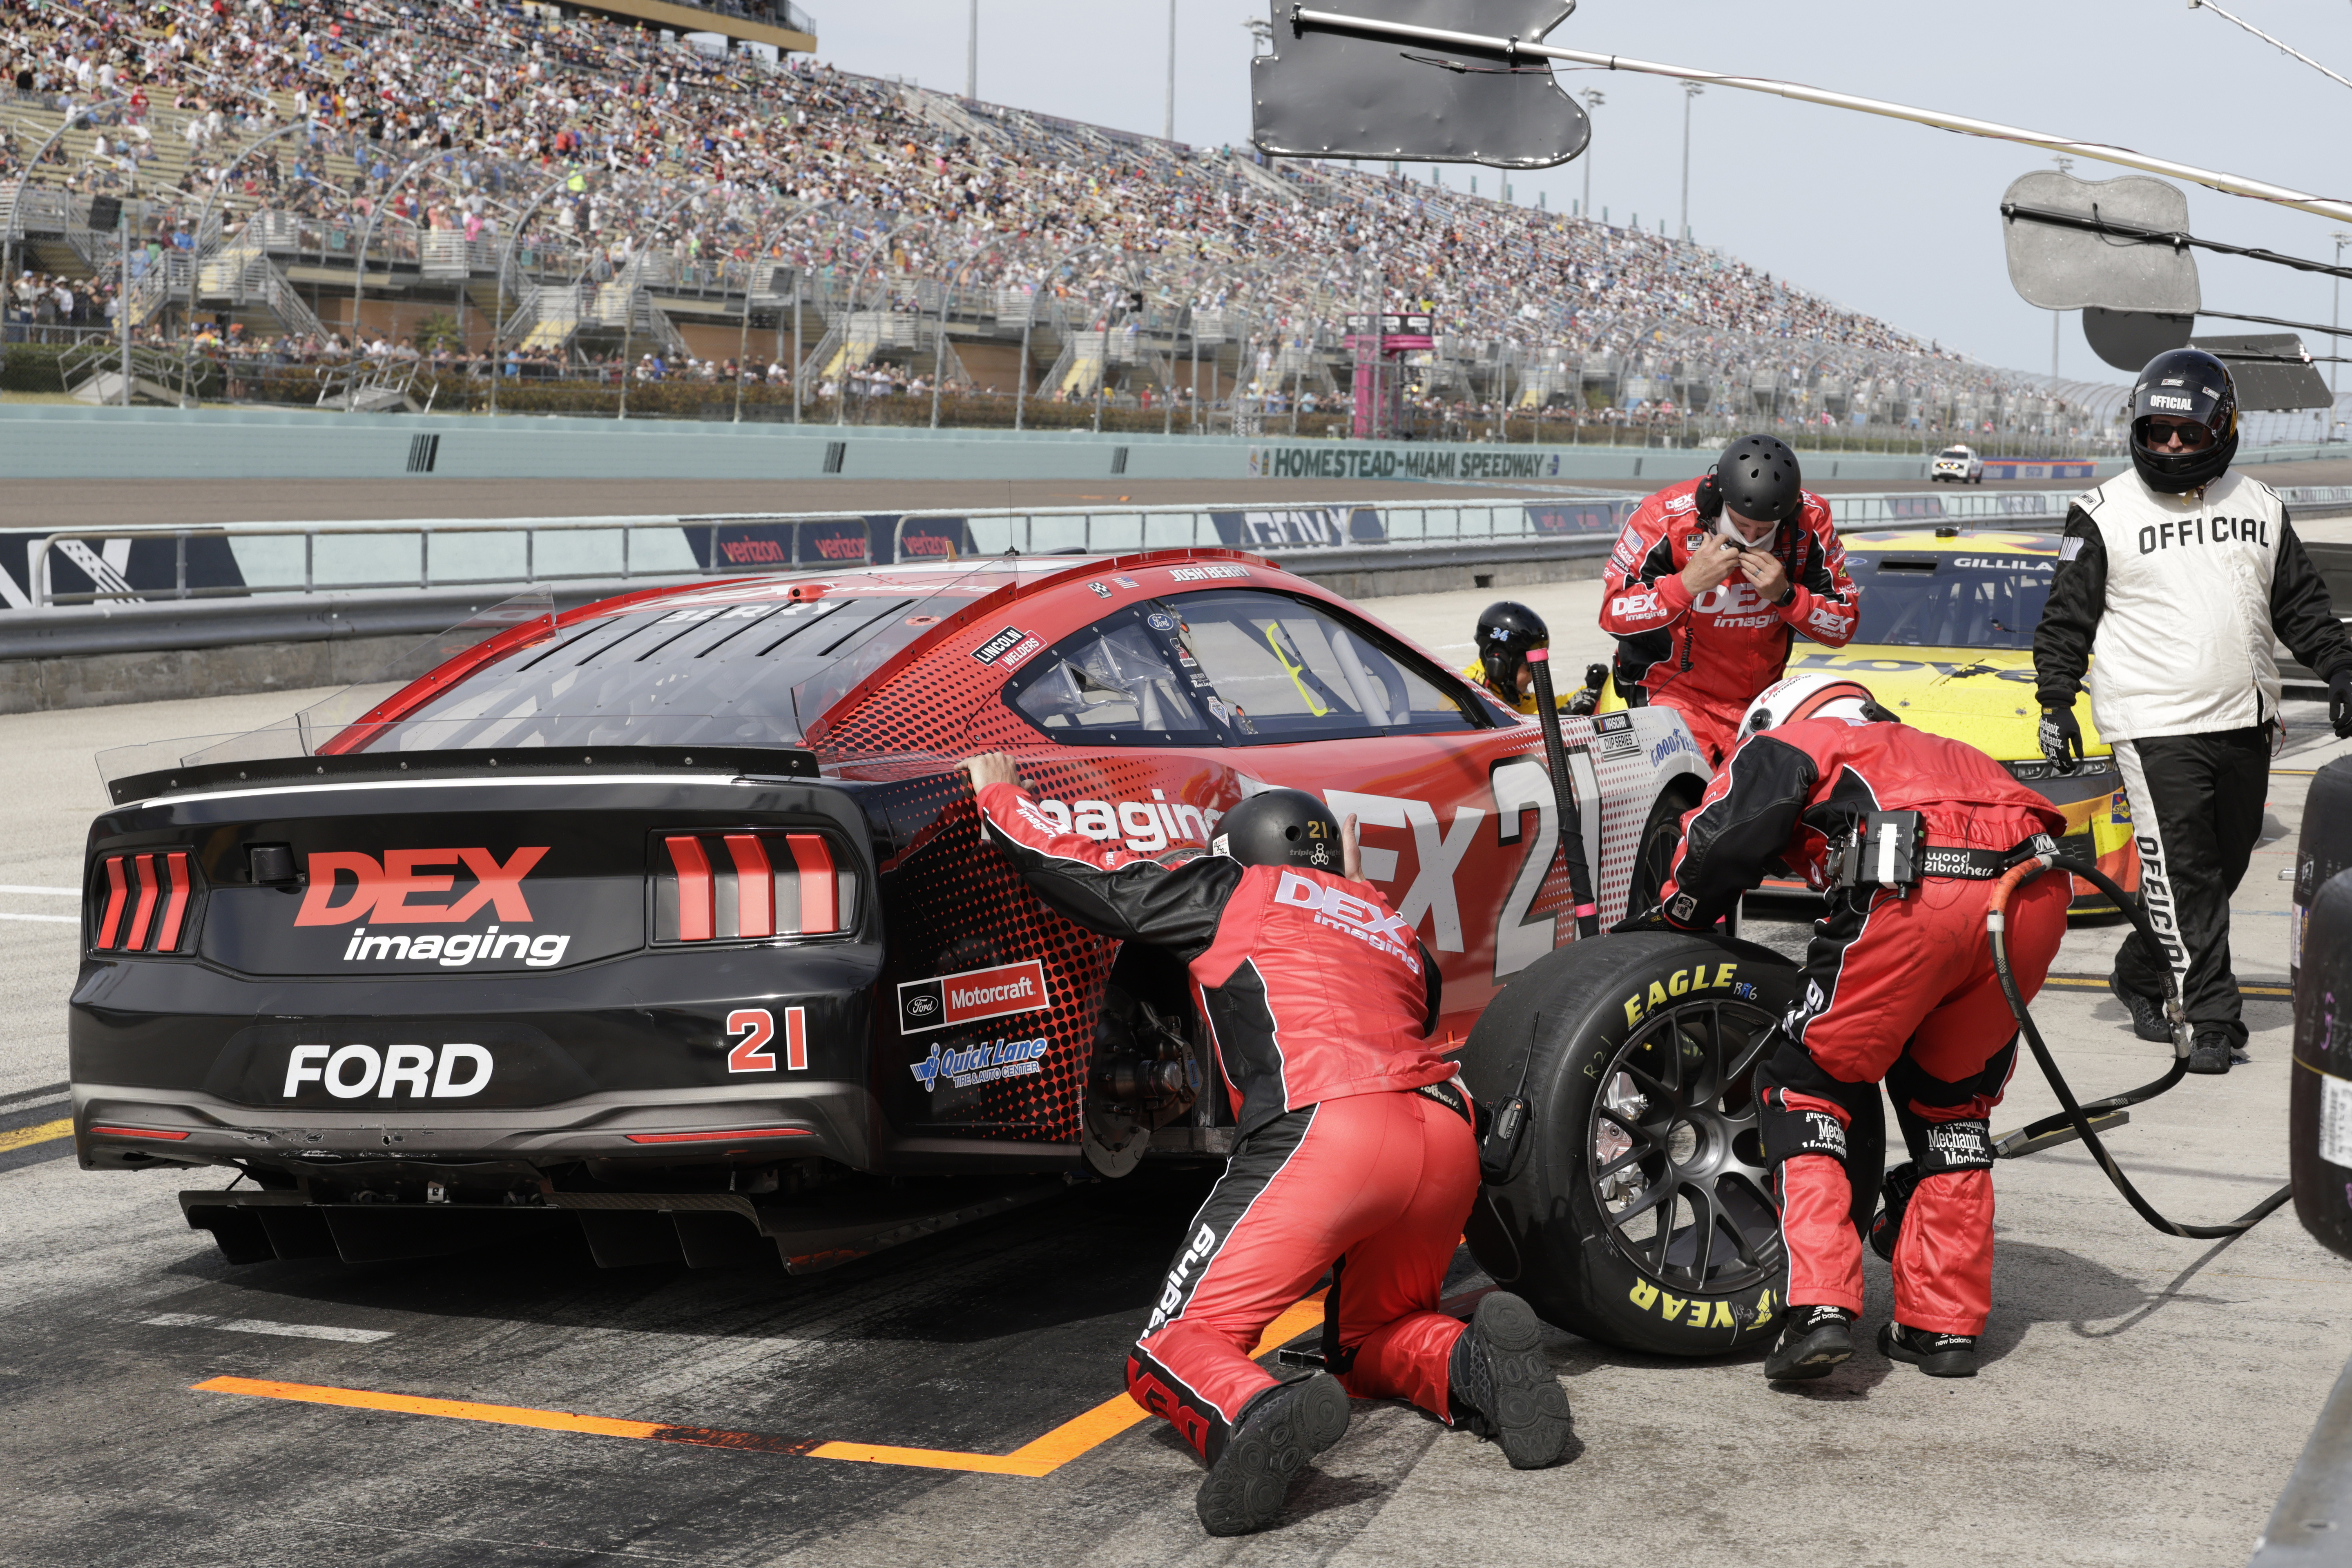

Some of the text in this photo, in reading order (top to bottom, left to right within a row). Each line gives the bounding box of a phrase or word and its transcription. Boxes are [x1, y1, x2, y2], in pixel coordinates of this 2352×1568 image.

[2150, 395, 2192, 410] OFFICIAL
[1274, 448, 1545, 477] HOMESTEAD-MIAMI SPEEDWAY
[1665, 493, 1694, 509] DEX
[2139, 517, 2269, 555] OFFICIAL
[720, 535, 785, 562] verizon
[1617, 543, 1636, 562] FORD
[1168, 565, 1251, 582] JOSH BERRY
[1611, 554, 1629, 571] LINCOLN
[1954, 558, 2055, 571] GILLILA
[655, 600, 858, 623] BERRY
[1612, 592, 1658, 616] DEX
[1626, 608, 1667, 621] imaging
[1151, 615, 1170, 628] Ford
[1809, 608, 1854, 633] DEX
[1490, 627, 1510, 641] 34
[1812, 626, 1848, 640] imaging
[976, 629, 1023, 662] LINCOLN
[1002, 637, 1040, 667] WELDERS
[1191, 680, 1213, 688] Racing
[1760, 674, 1802, 705] DEX
[1773, 674, 1811, 698] imaging
[1605, 715, 1627, 731] NASCAR
[1604, 734, 1633, 750] CUP SERIES
[1016, 807, 1057, 839] imagin
[1307, 821, 1328, 839] 21
[1238, 773, 1485, 953] EX
[1326, 849, 1341, 858] eight
[1927, 851, 1970, 863] wood
[293, 846, 551, 927] DEX
[1274, 870, 1408, 948] DEX
[343, 926, 570, 966] imaging
[1313, 911, 1419, 975] imaging
[952, 976, 1034, 1010] Motorcraft
[1624, 963, 1738, 1029] EAGLE
[912, 996, 933, 1016] Ford
[727, 1006, 808, 1073] 21
[940, 1037, 1048, 1078] Quick Lane
[283, 1044, 493, 1099] FORD
[953, 1062, 1041, 1088] TIRE & AUTO CENTER
[1926, 1129, 1980, 1151] Mechanix
[1629, 1276, 1737, 1328] YEAR
[1807, 1312, 1847, 1327] new balance
[1935, 1338, 1949, 1347] new
